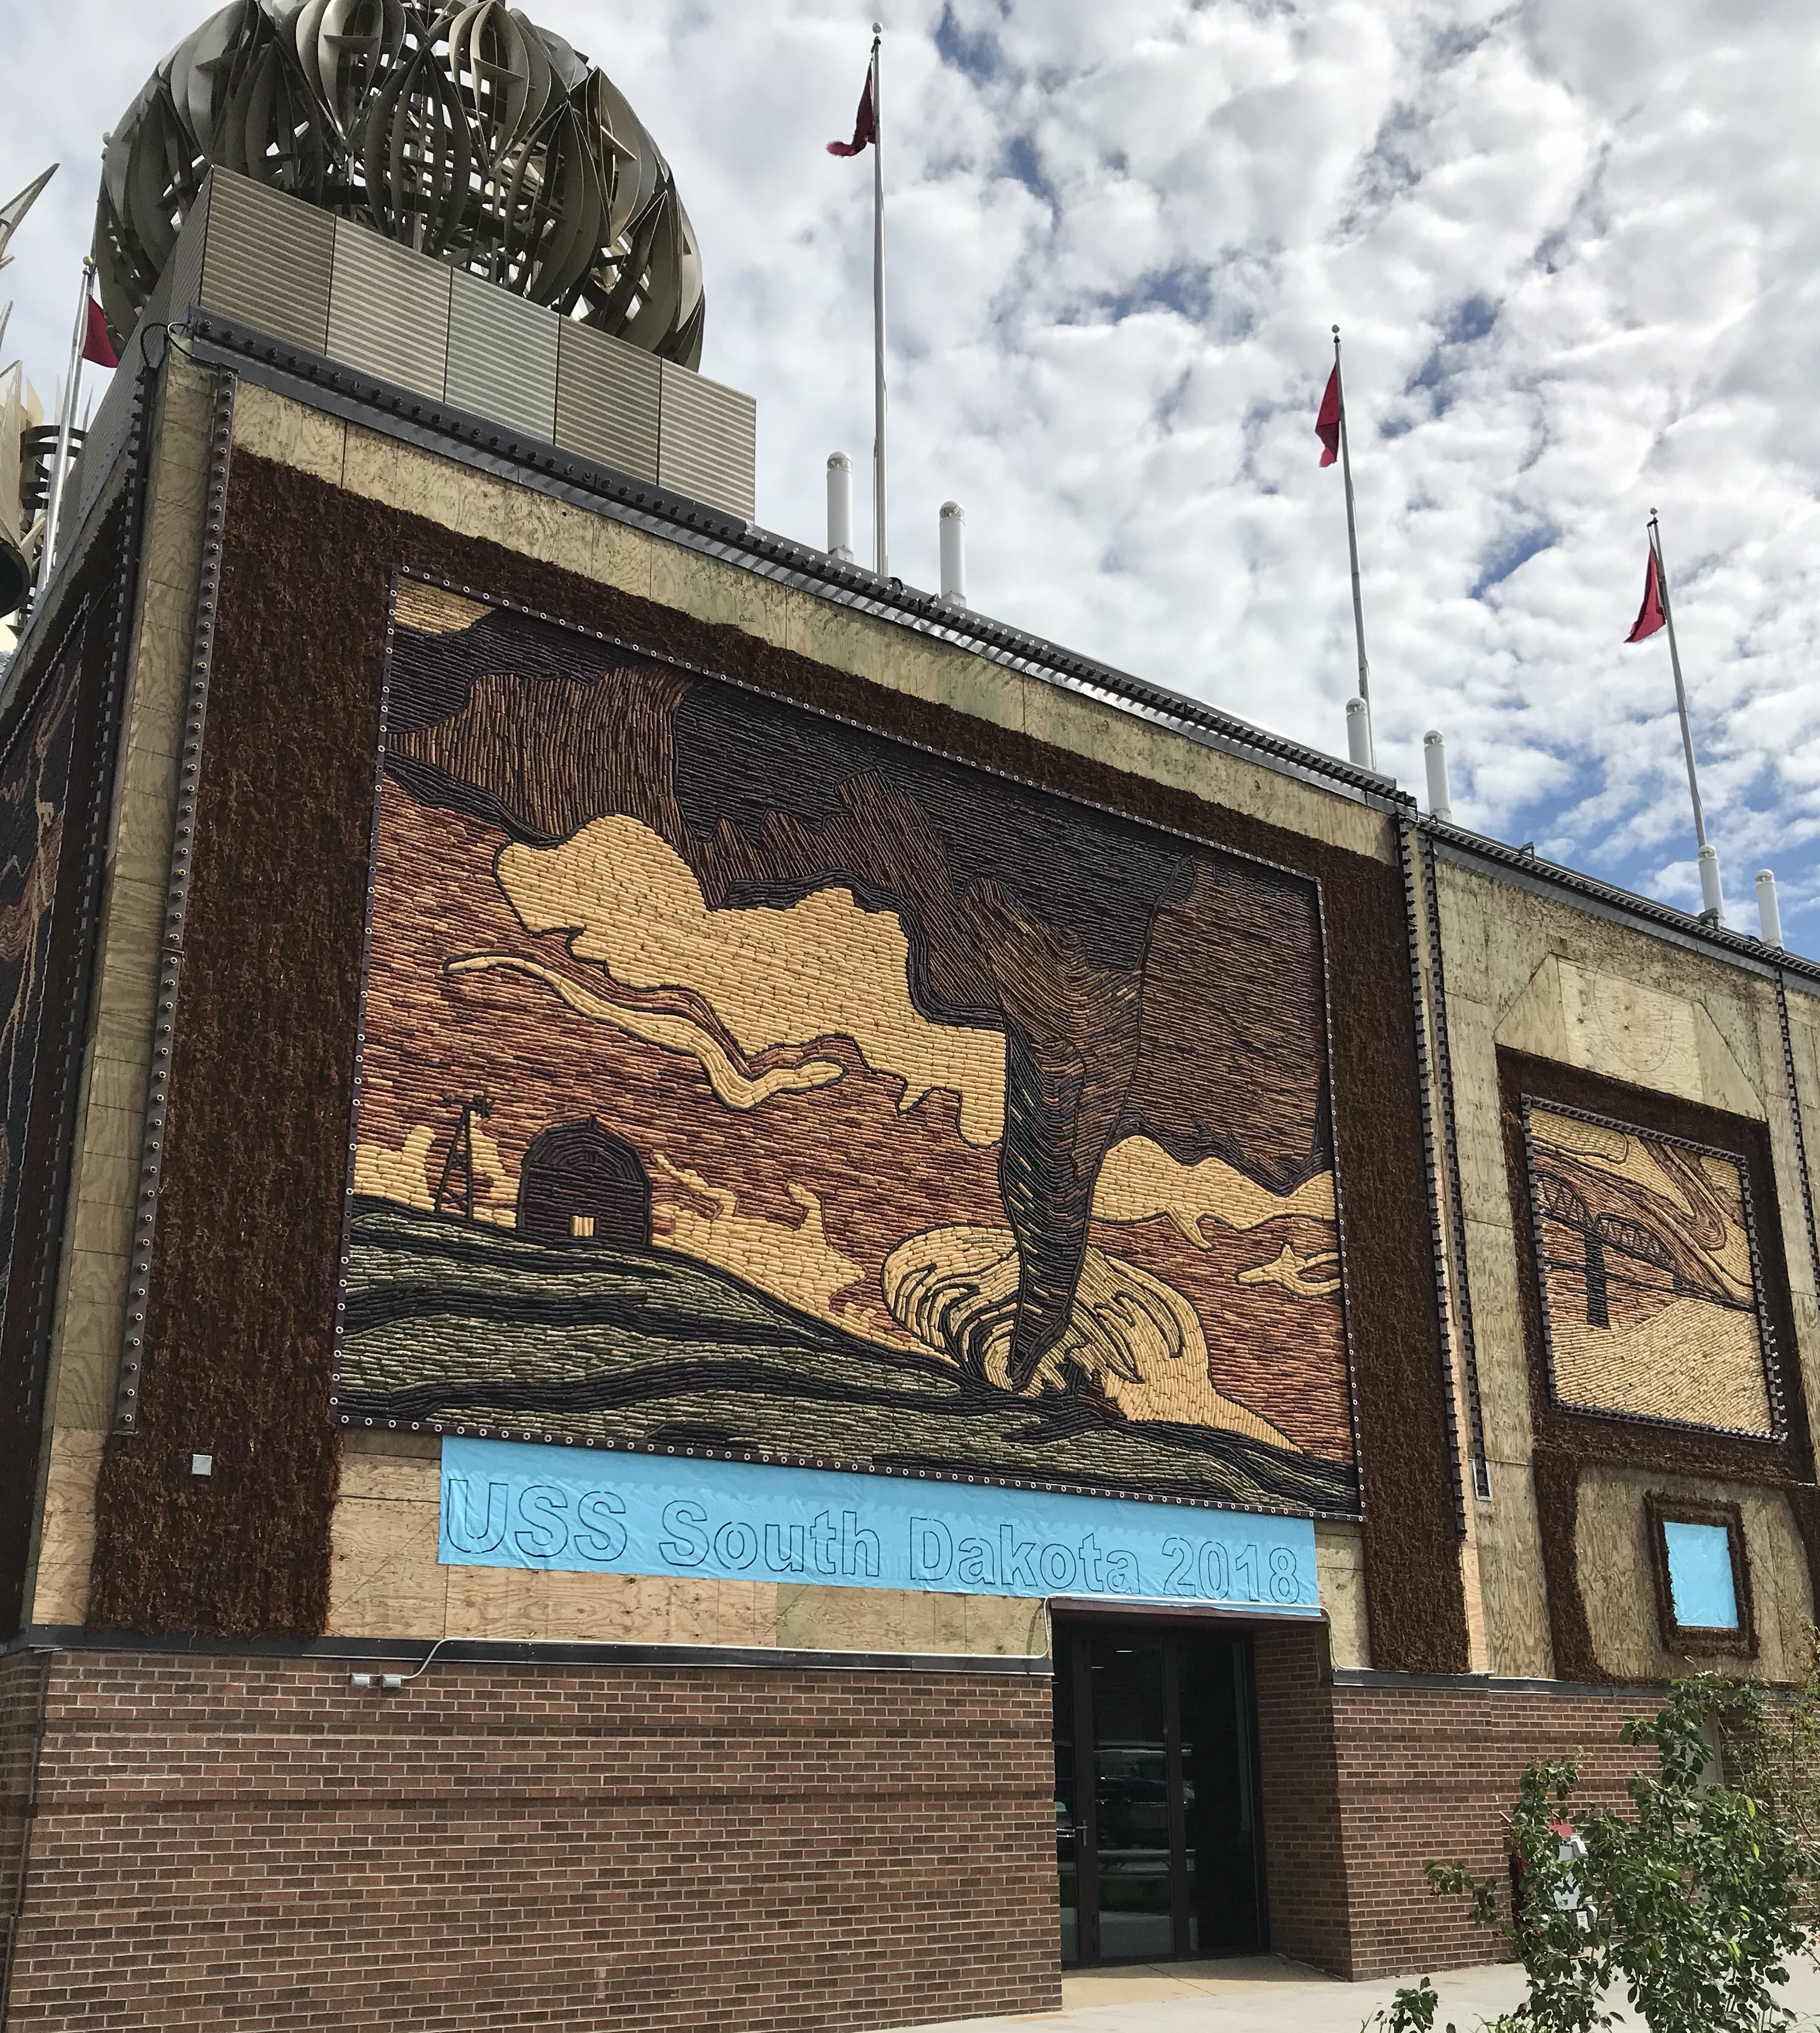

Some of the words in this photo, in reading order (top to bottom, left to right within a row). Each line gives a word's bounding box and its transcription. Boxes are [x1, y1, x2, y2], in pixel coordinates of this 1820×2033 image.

[446, 1478, 628, 1562] USS
[658, 1499, 881, 1577] South
[909, 1516, 1141, 1595] Dakota
[1162, 1537, 1301, 1605] 2018
